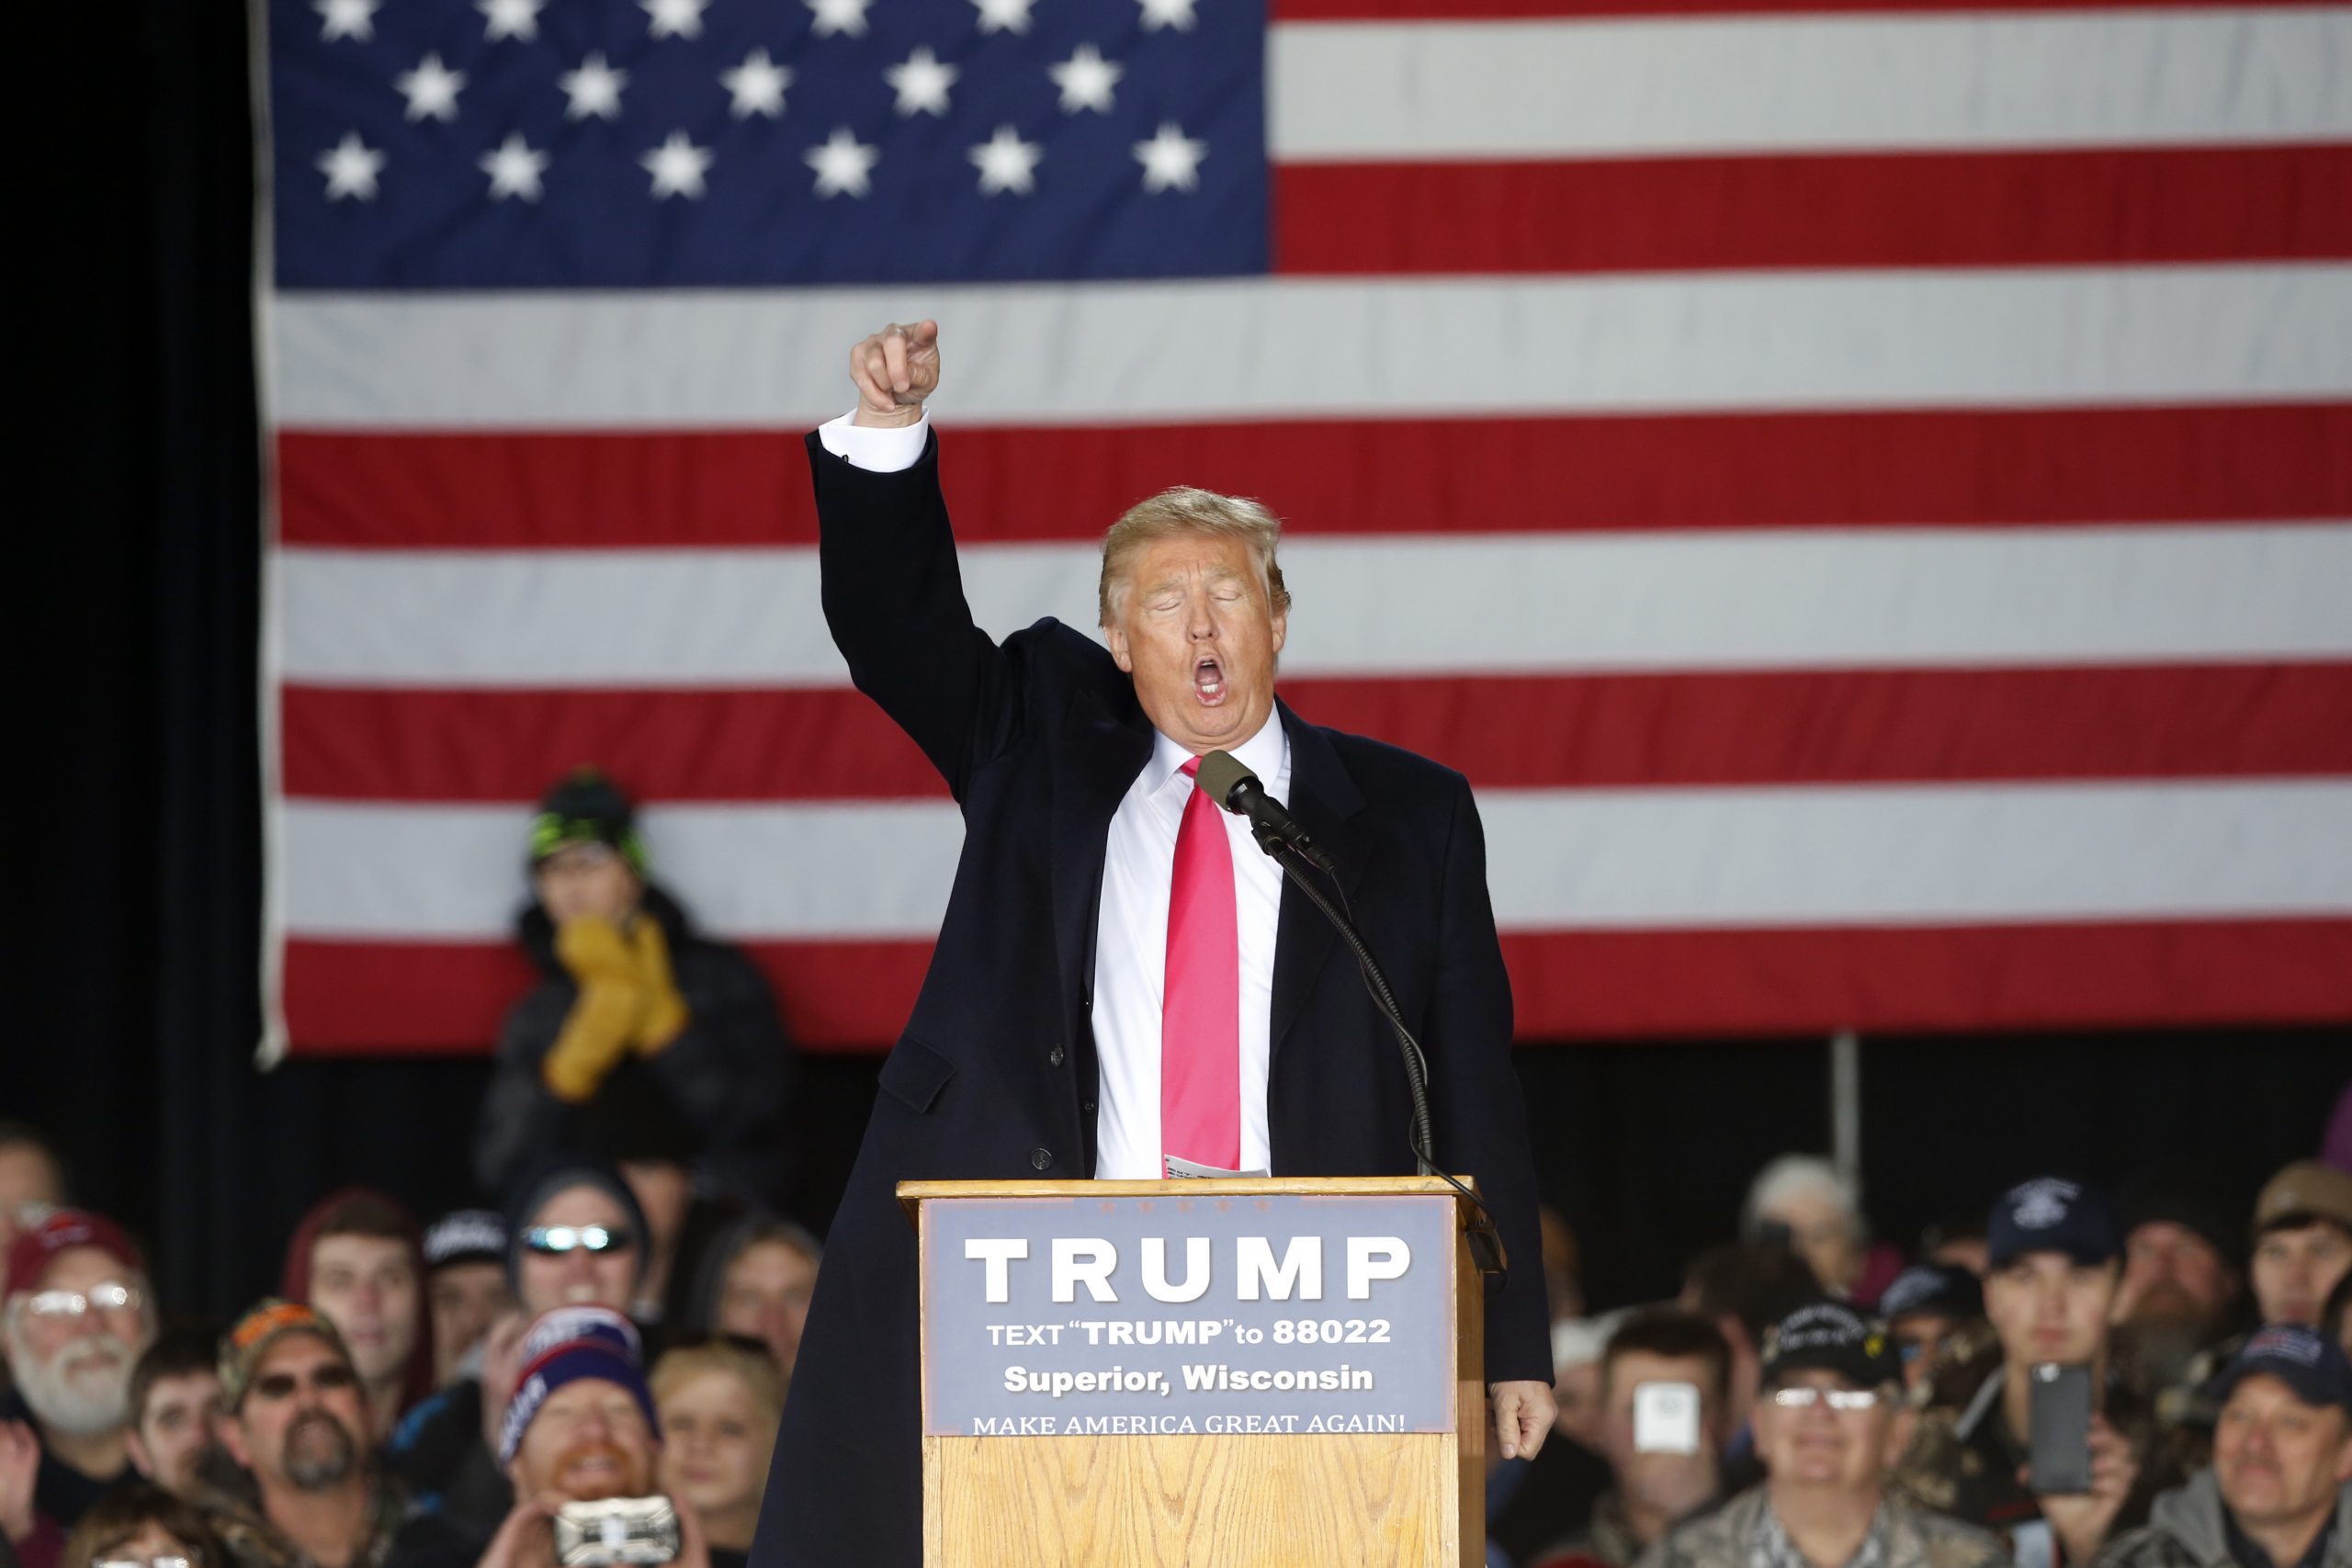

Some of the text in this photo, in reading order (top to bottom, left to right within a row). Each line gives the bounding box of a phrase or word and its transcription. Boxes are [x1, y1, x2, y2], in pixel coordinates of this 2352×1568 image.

[965, 1235, 1411, 1303] TRUMP
[986, 1324, 1064, 1346] TEXT
[1234, 1325, 1264, 1345] to
[1272, 1319, 1391, 1345] 88022
[1003, 1364, 1373, 1398] Superior, Wisconsin
[973, 1414, 1406, 1436] MAKE AMERICA GREAT AGAIN!
